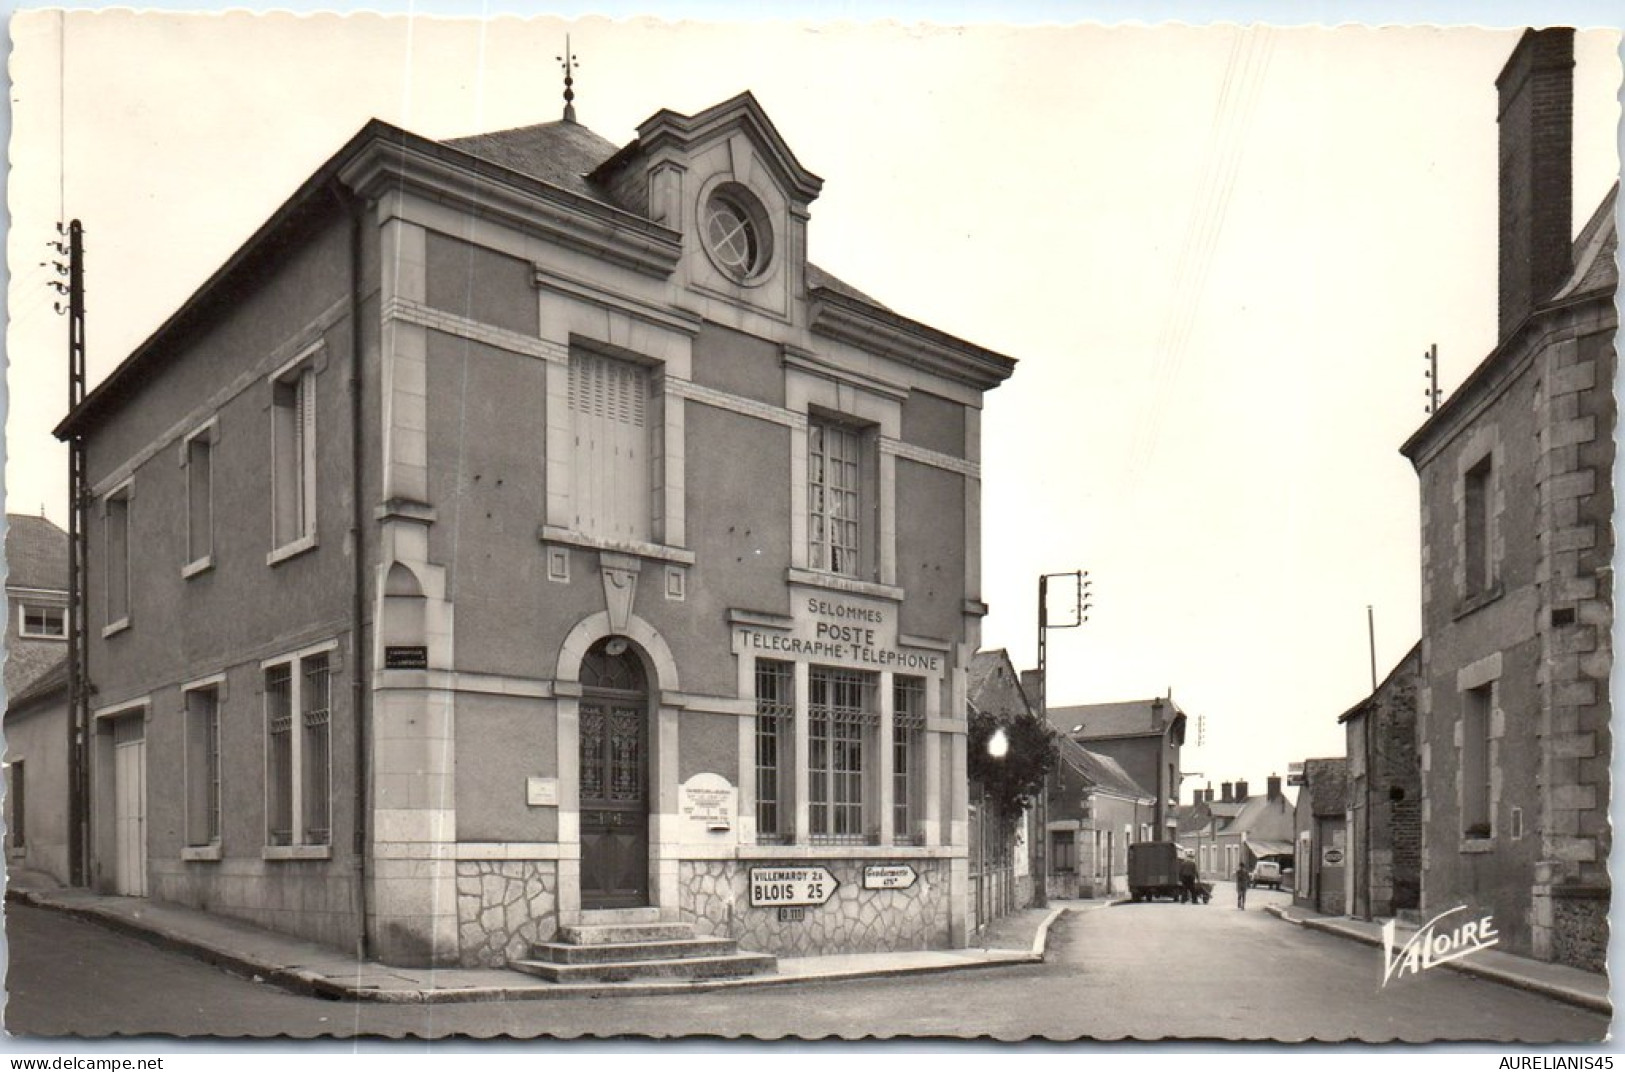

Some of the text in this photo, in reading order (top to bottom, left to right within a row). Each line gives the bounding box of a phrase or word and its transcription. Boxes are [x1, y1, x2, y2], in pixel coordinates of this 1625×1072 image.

[816, 622, 875, 646] POSTE
[755, 883, 823, 901] BLOIS 25
